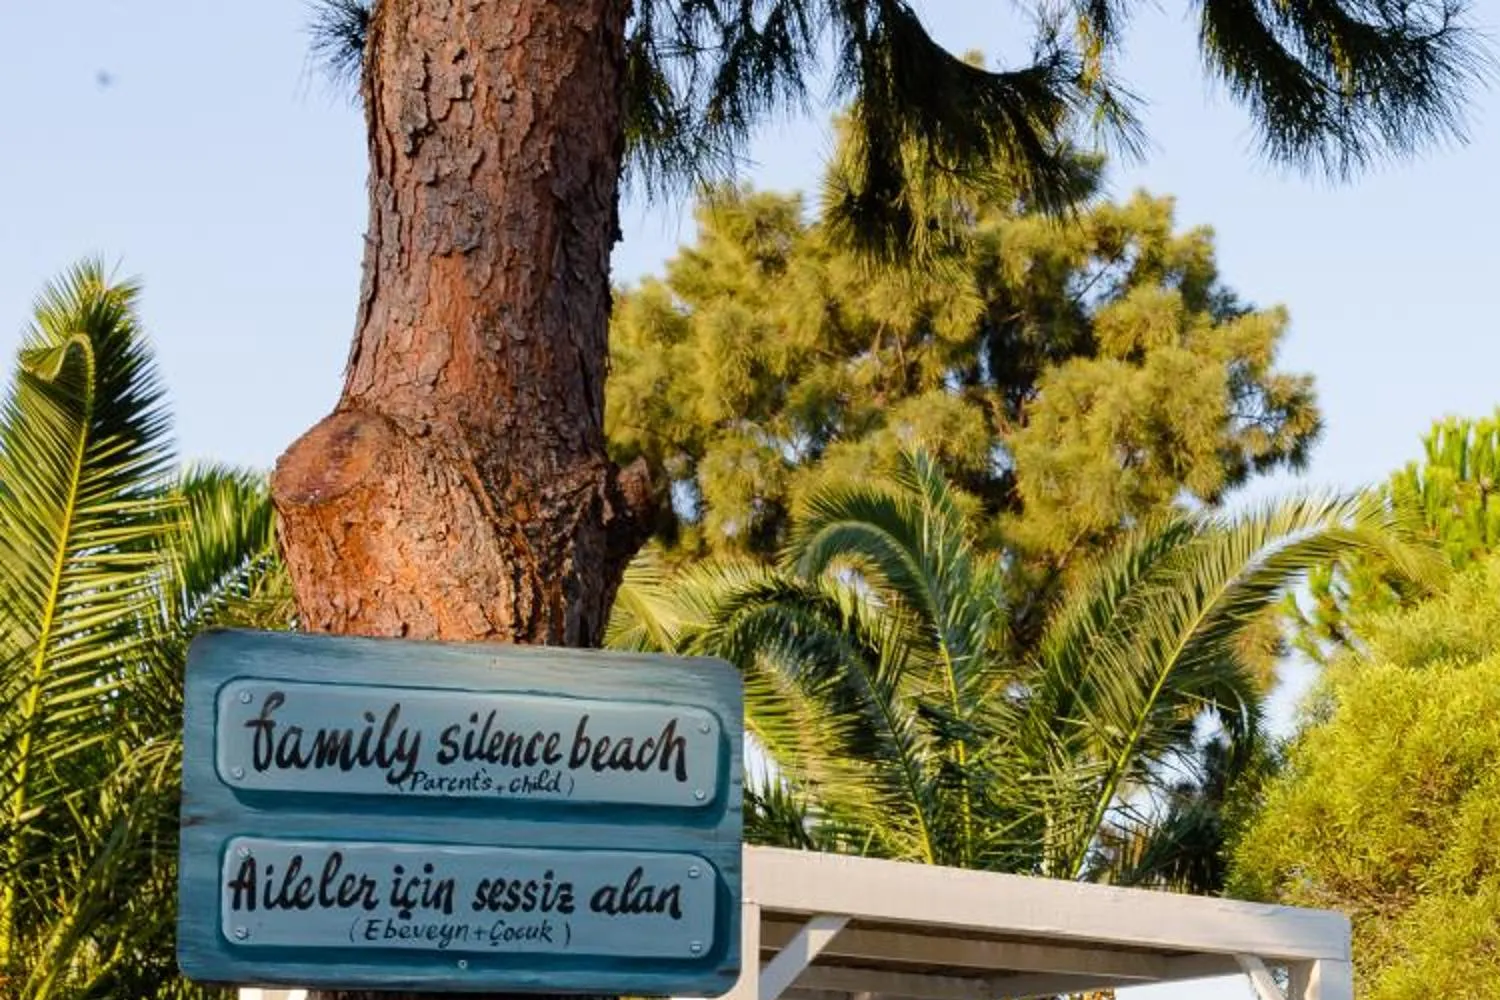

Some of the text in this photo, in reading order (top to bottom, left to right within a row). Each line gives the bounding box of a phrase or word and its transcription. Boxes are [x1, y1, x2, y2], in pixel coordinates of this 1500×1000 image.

[244, 691, 688, 784] family silence beach
[229, 850, 683, 920] Aileler için sessiz alan
